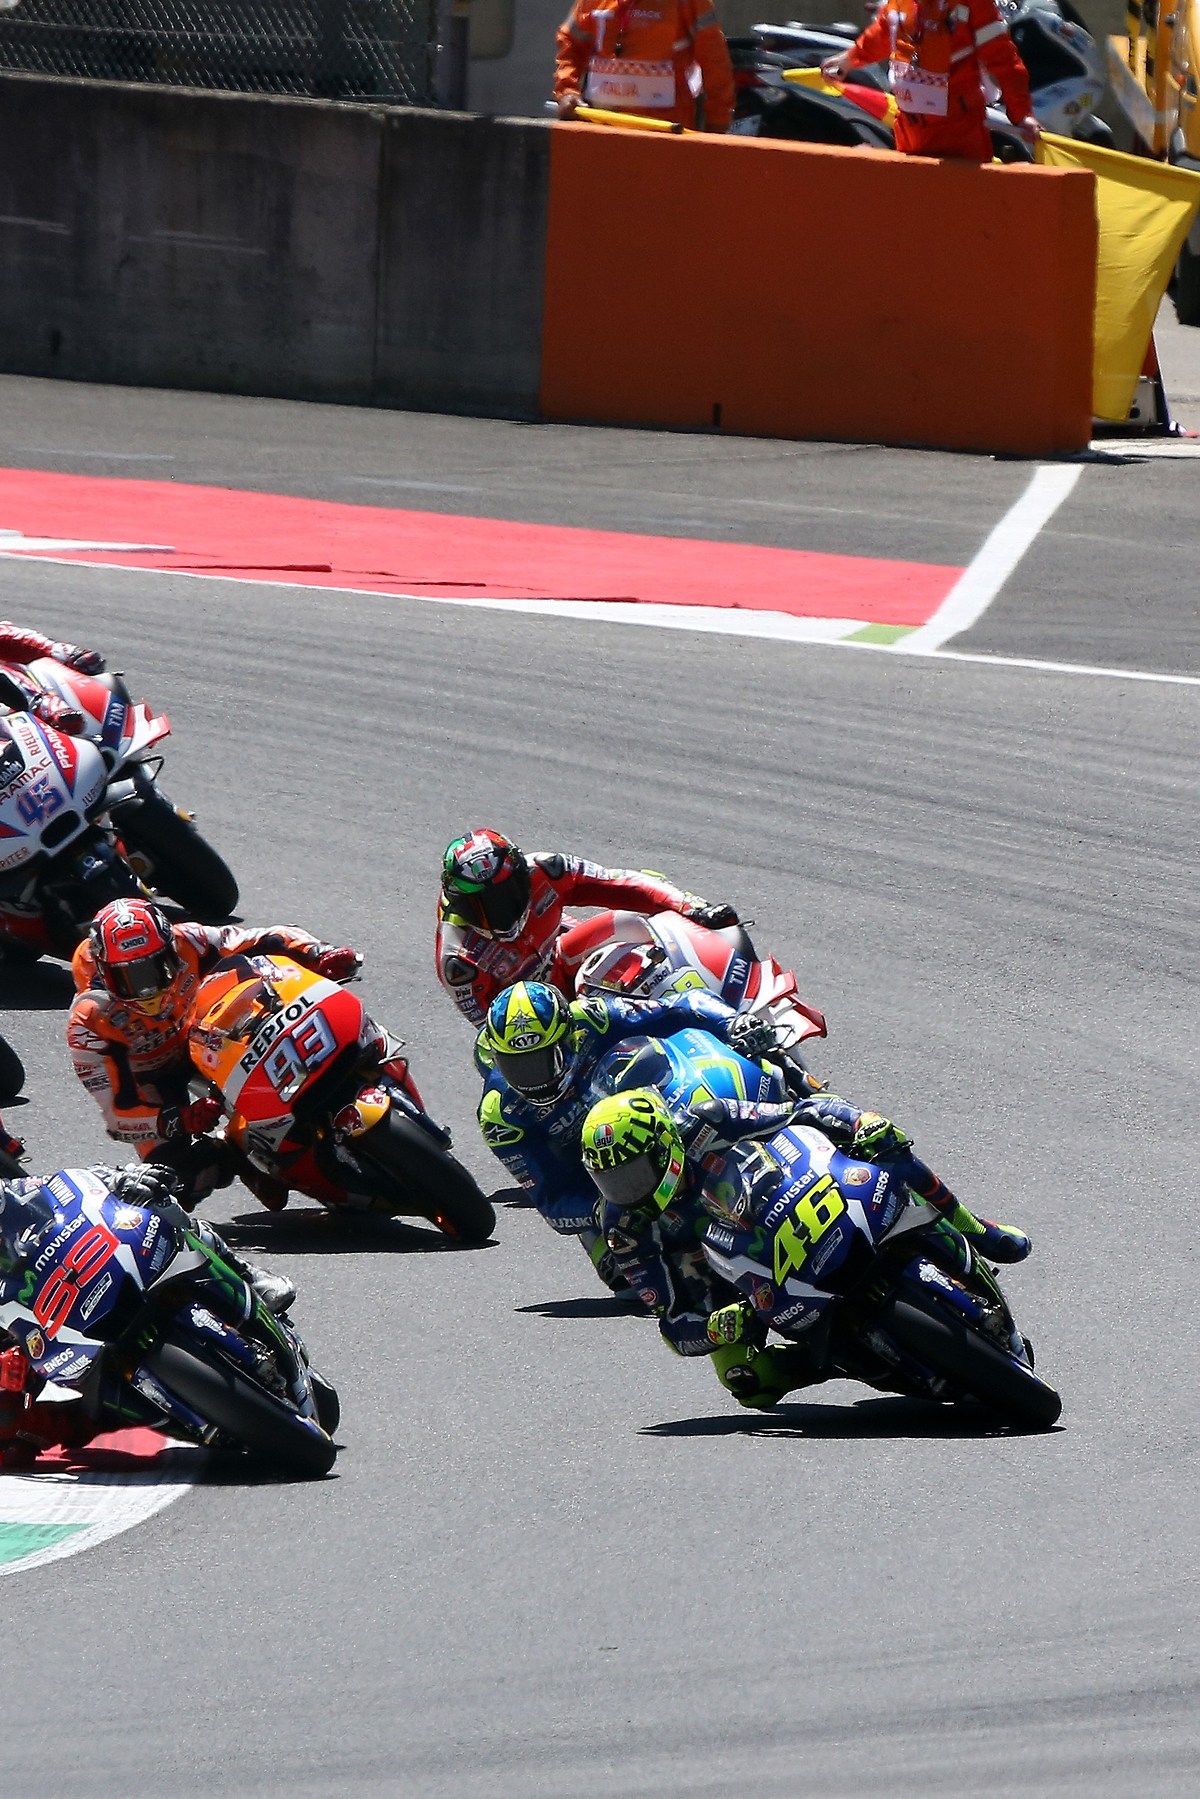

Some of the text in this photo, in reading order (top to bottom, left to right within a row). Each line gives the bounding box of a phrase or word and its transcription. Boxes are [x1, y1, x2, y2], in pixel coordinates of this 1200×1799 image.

[108, 702, 125, 727] TIM
[19, 727, 40, 757] RIELLO
[16, 775, 66, 827] 45
[121, 936, 147, 949] SHOEI
[729, 958, 748, 985] TIM
[240, 996, 314, 1074] REPSOL
[511, 1032, 538, 1049] KYT
[263, 1008, 338, 1103] 93
[770, 1132, 802, 1165] YAMAHA
[50, 1174, 76, 1207] YAMAHA
[764, 1168, 816, 1229] movistar
[872, 1170, 890, 1205] ENEOS
[35, 1212, 86, 1273] movistar
[142, 1214, 161, 1249] ENEOS
[706, 1222, 735, 1250] YAMAHA
[772, 1173, 849, 1287] 46
[33, 1223, 121, 1341] 99
[773, 1302, 805, 1325] ENEOS
[43, 1347, 75, 1373] ENEOS
